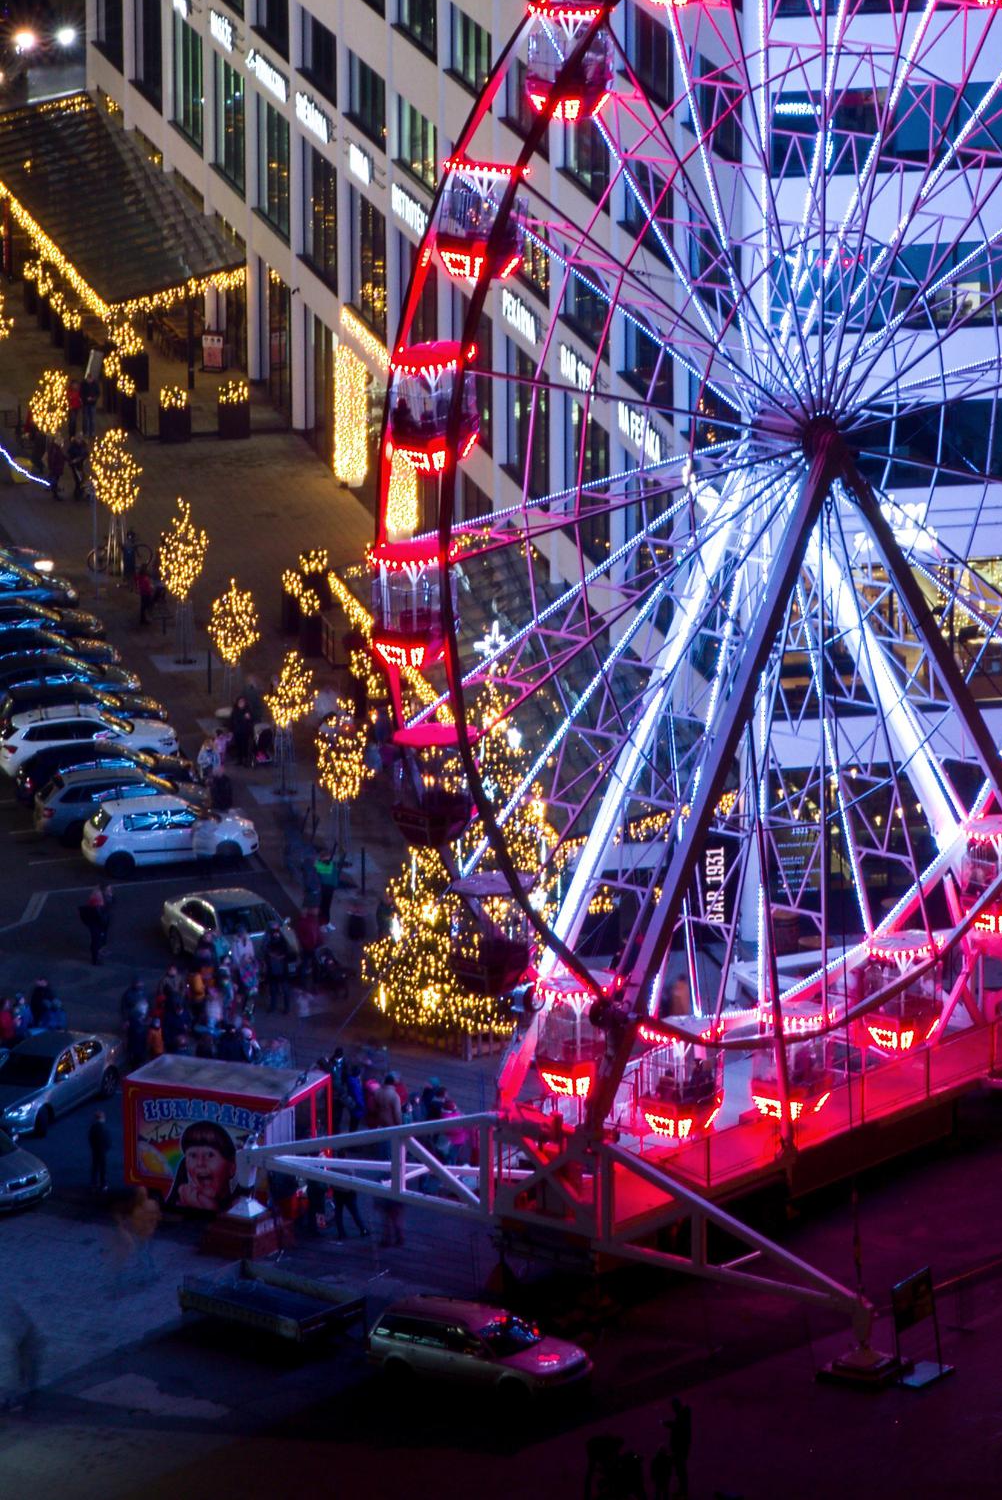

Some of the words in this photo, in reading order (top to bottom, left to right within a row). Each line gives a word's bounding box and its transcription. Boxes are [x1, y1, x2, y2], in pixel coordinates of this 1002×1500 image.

[391, 183, 428, 238] BISTROTÉK
[561, 344, 577, 385] BAR
[706, 846, 725, 885] 1931
[706, 890, 725, 924] BAR
